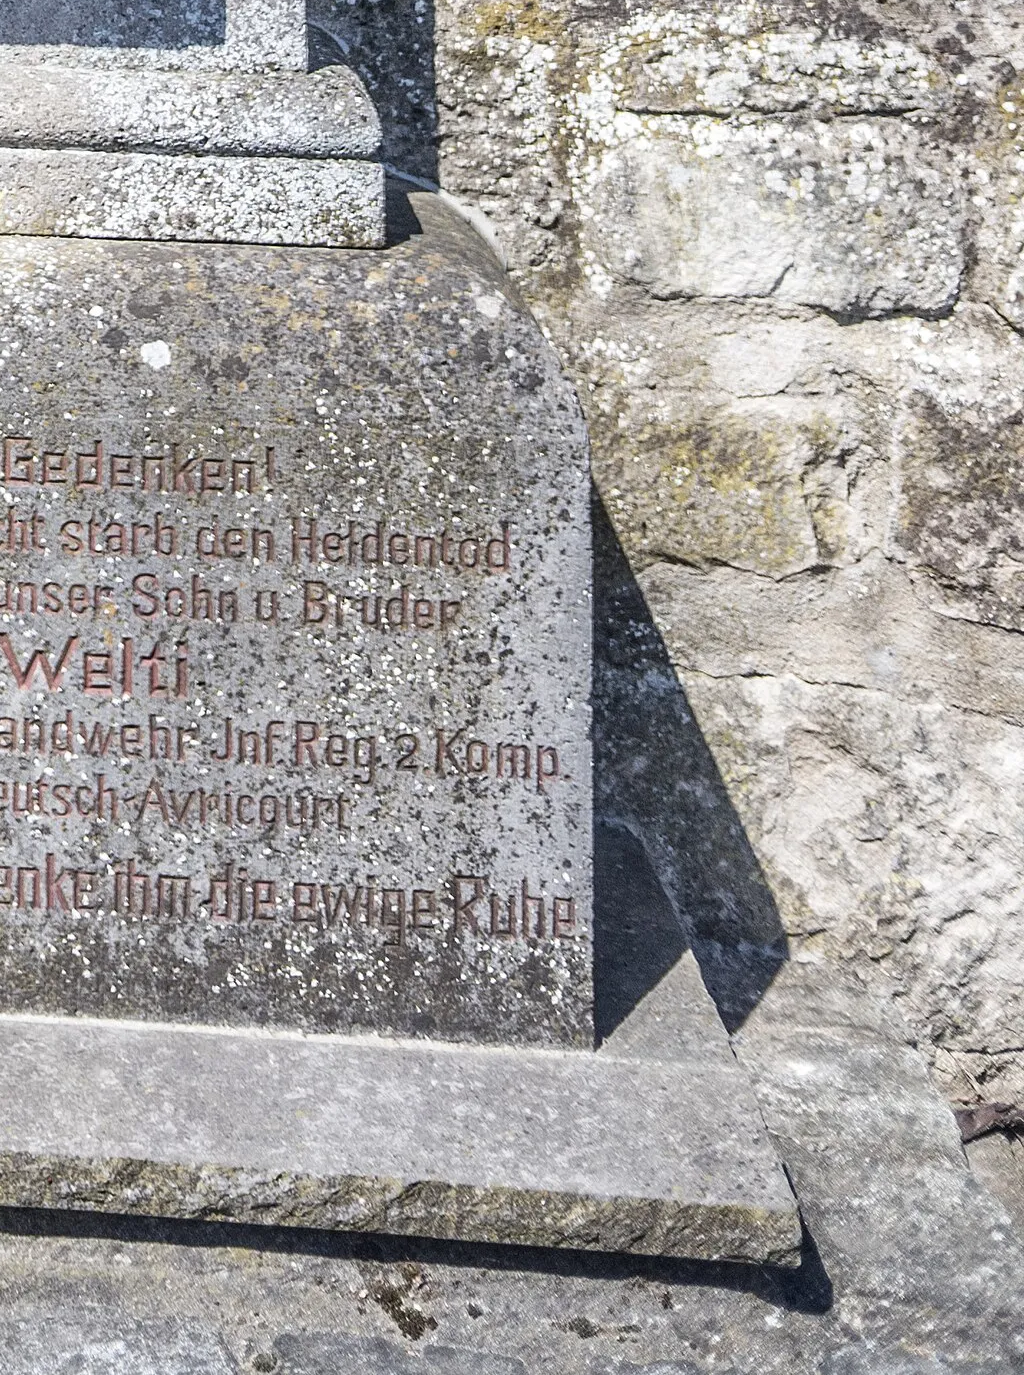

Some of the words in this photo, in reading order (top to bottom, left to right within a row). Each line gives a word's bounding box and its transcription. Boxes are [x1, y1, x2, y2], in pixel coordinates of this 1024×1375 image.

[0, 436, 276, 496] Gedenken!
[59, 510, 176, 557] starb
[196, 514, 274, 562] den
[292, 517, 511, 573] Heldentod
[132, 572, 238, 622] Sohn
[303, 579, 462, 634] Bruder
[113, 857, 192, 918] ihm
[206, 860, 276, 922] die
[292, 874, 436, 950] ewige
[452, 874, 578, 940] Ruhe
